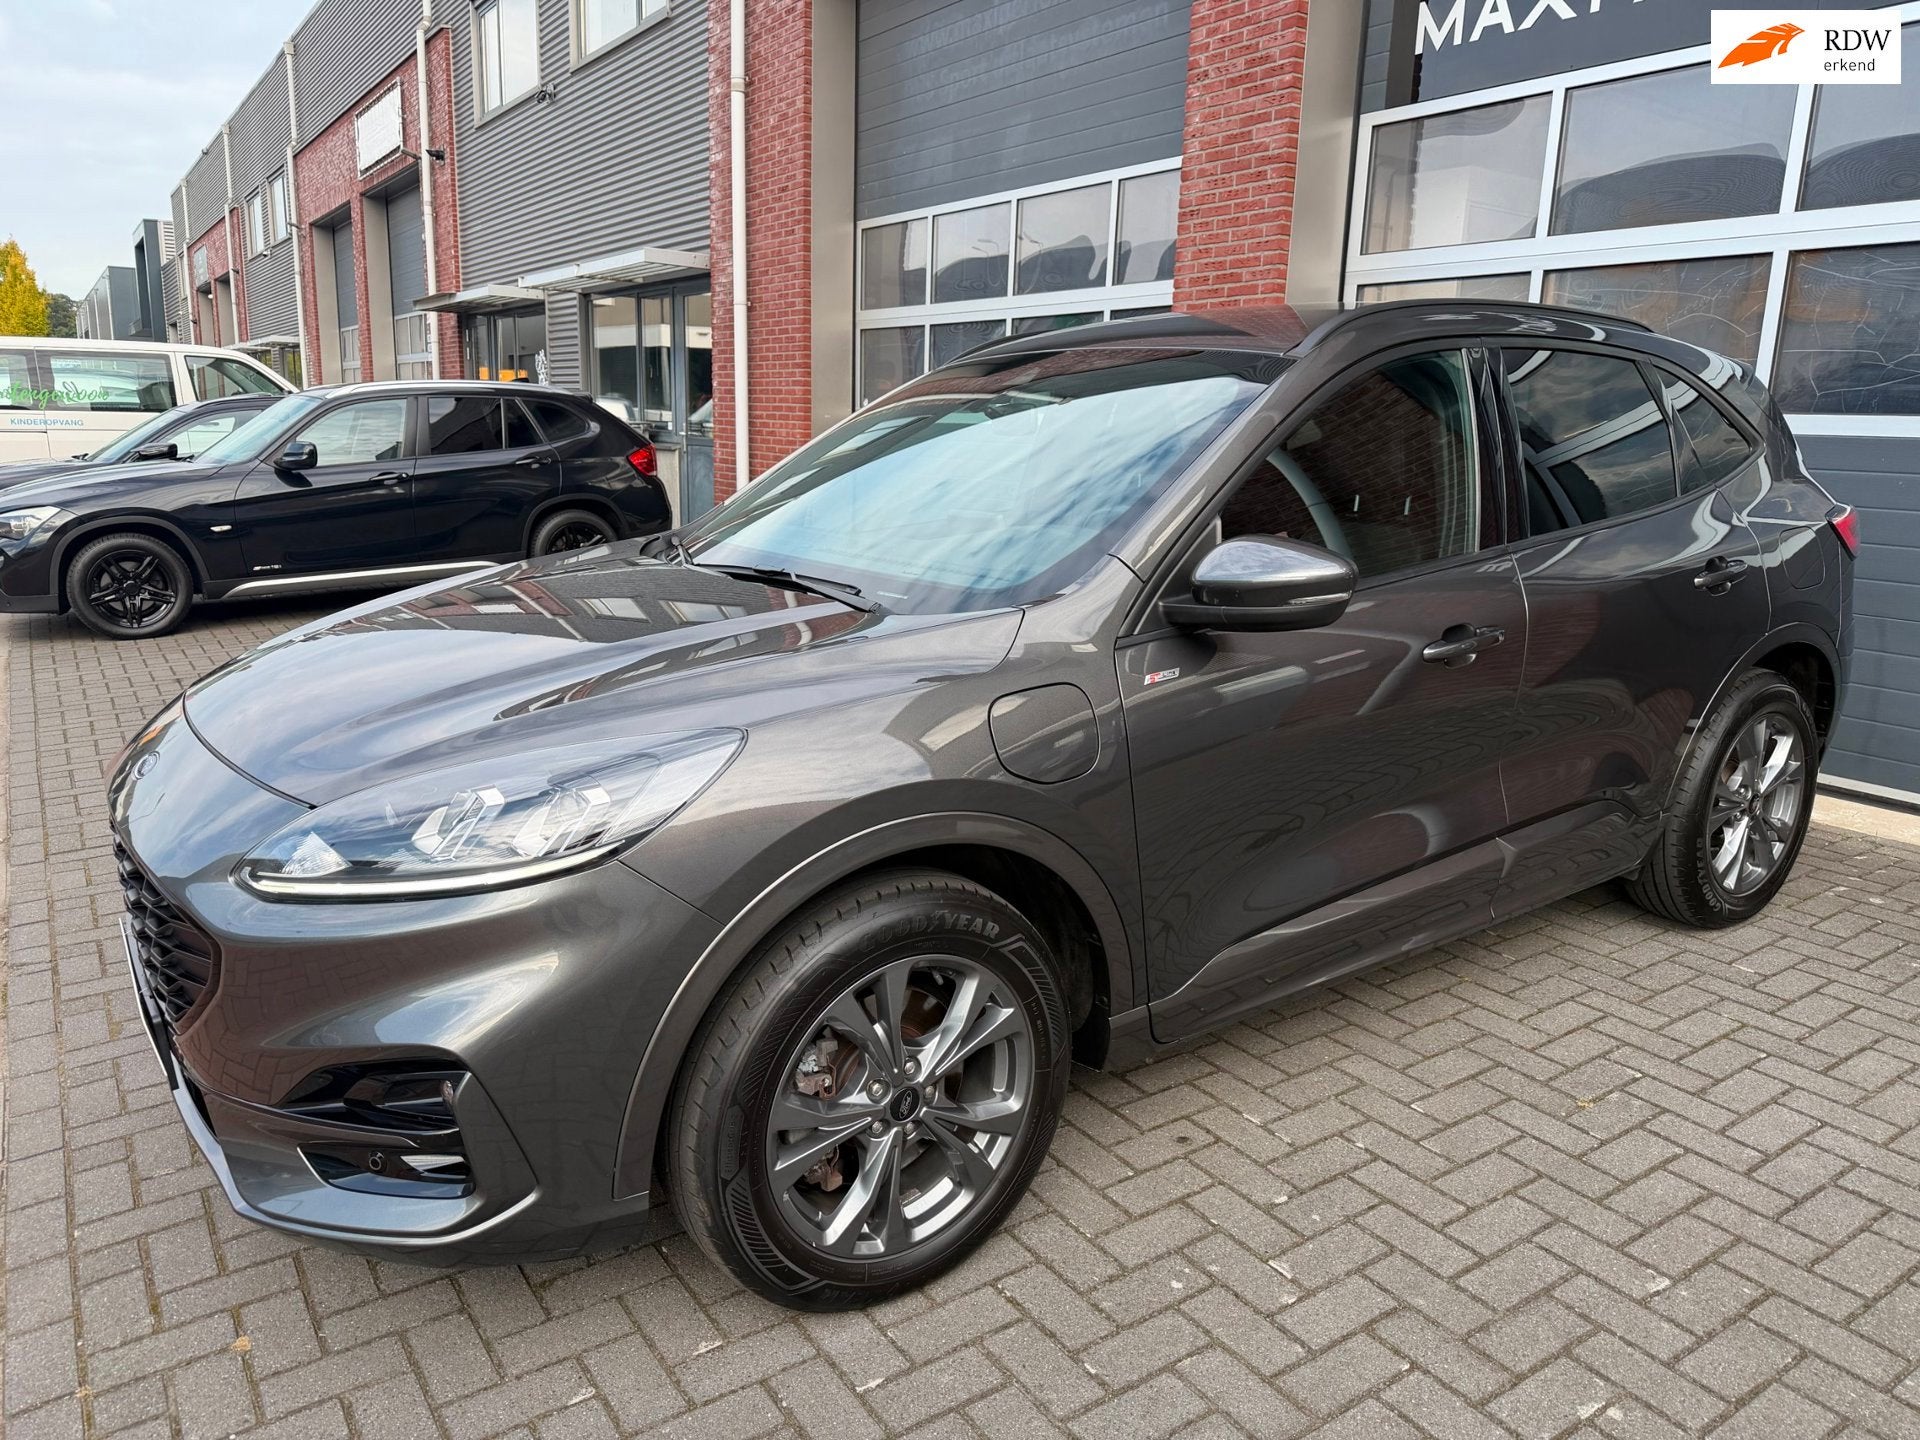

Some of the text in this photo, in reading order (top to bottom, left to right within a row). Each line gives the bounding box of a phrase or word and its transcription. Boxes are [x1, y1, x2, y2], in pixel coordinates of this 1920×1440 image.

[10, 417, 84, 427] KINDEROPVANG
[1696, 837, 1722, 912] GOODYEAR
[857, 909, 1000, 953] GOODYEAR
